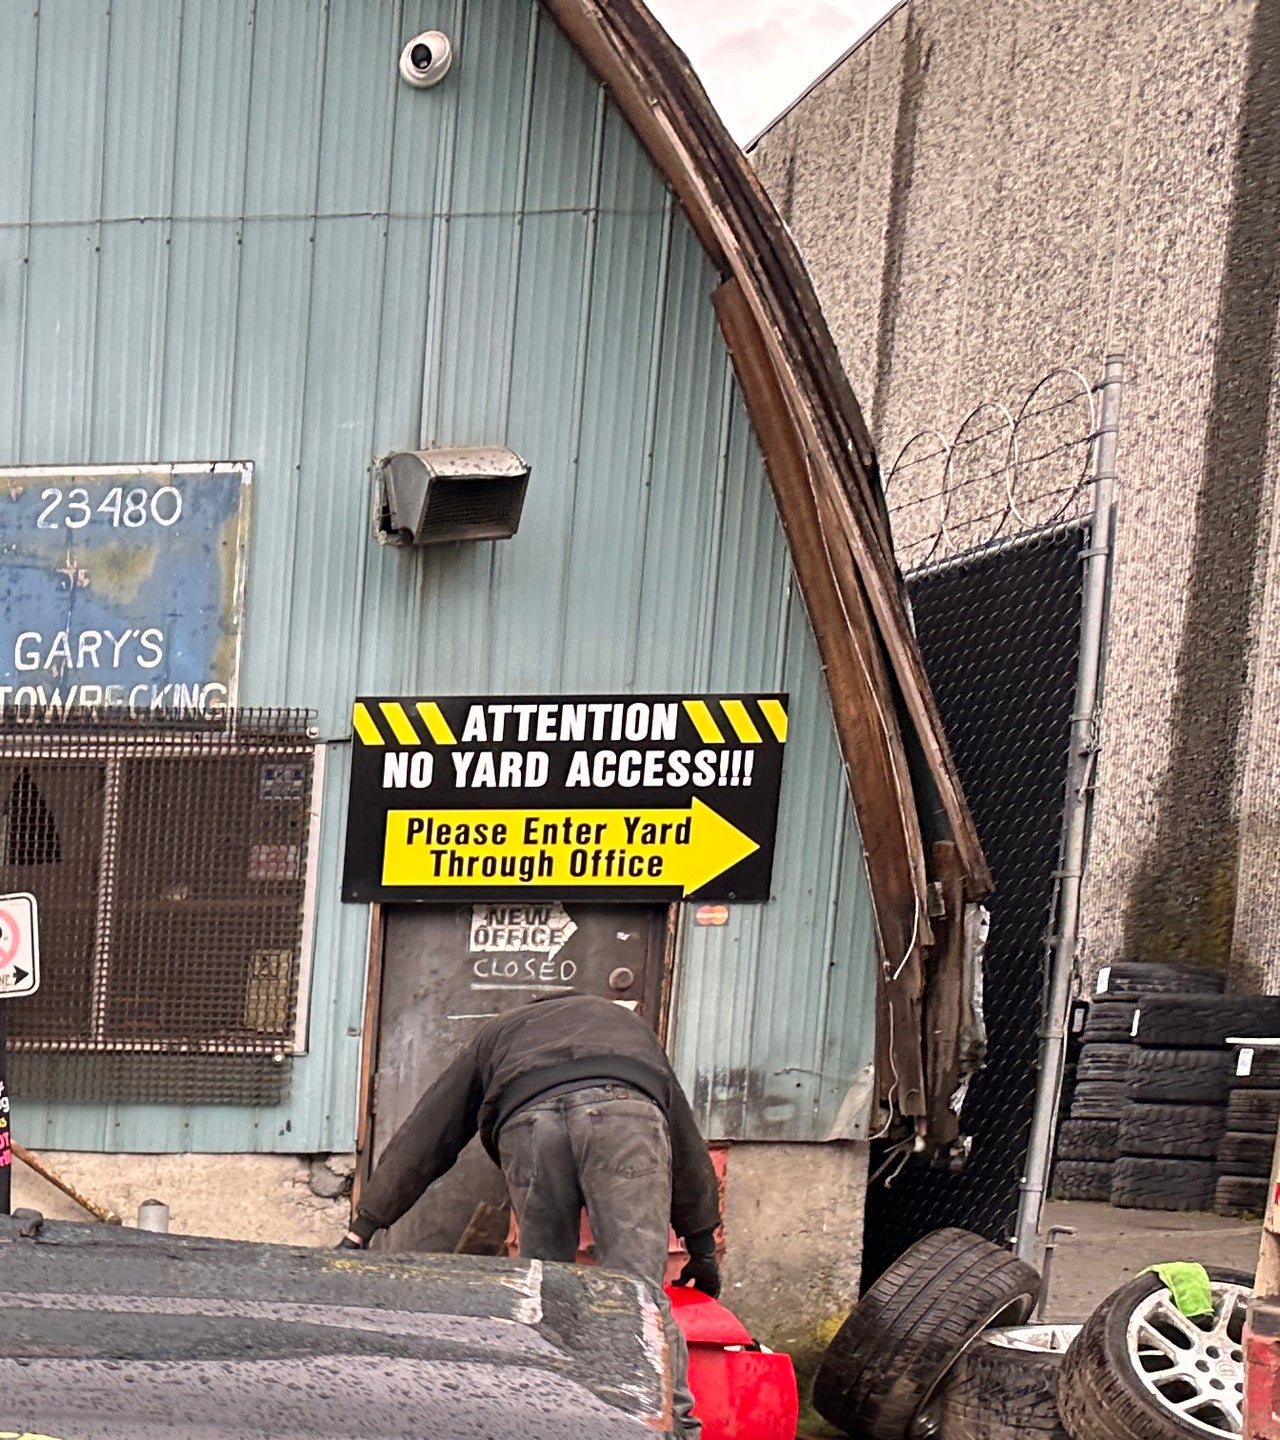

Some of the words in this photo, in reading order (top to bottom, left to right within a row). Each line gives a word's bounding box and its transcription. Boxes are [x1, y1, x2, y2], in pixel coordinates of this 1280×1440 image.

[36, 486, 183, 529] 23480
[14, 628, 164, 671] GARY'S
[461, 702, 679, 743] ATTENTION
[381, 751, 434, 789] NO
[451, 750, 550, 789] YARD
[565, 749, 755, 788] ACCESS!!!
[406, 817, 507, 846] Please
[522, 816, 607, 846] Enter
[623, 816, 692, 845] Yard
[429, 849, 554, 882] Through
[569, 848, 664, 878] Office
[487, 906, 550, 926] NEW
[473, 924, 563, 948] OFFICE
[473, 958, 577, 981] CLOSED
